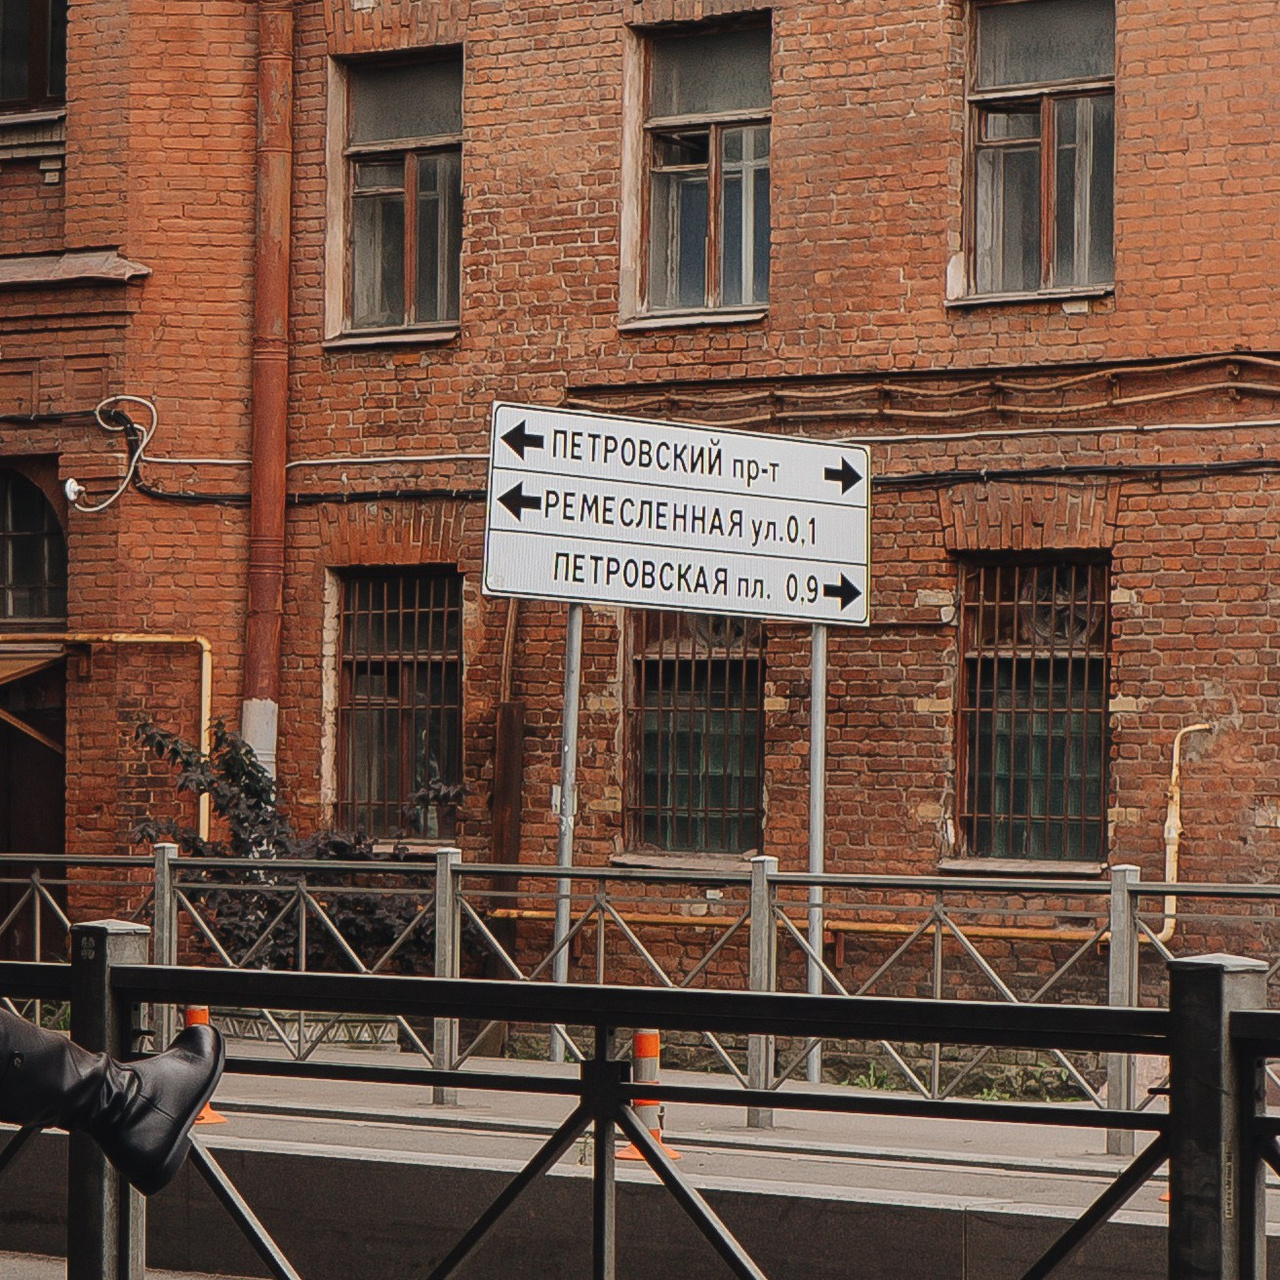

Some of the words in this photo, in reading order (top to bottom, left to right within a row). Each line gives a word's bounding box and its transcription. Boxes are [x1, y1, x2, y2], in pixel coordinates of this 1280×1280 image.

[552, 428, 722, 476] ПЕТРОВСКИЙ
[732, 458, 780, 487] пр-т
[544, 489, 743, 538] РЕМЕСЛЕННАЯ
[553, 552, 728, 597] ПЕТРОВСКАЯ
[737, 577, 771, 600] пл.
[786, 573, 819, 606] 0,9
